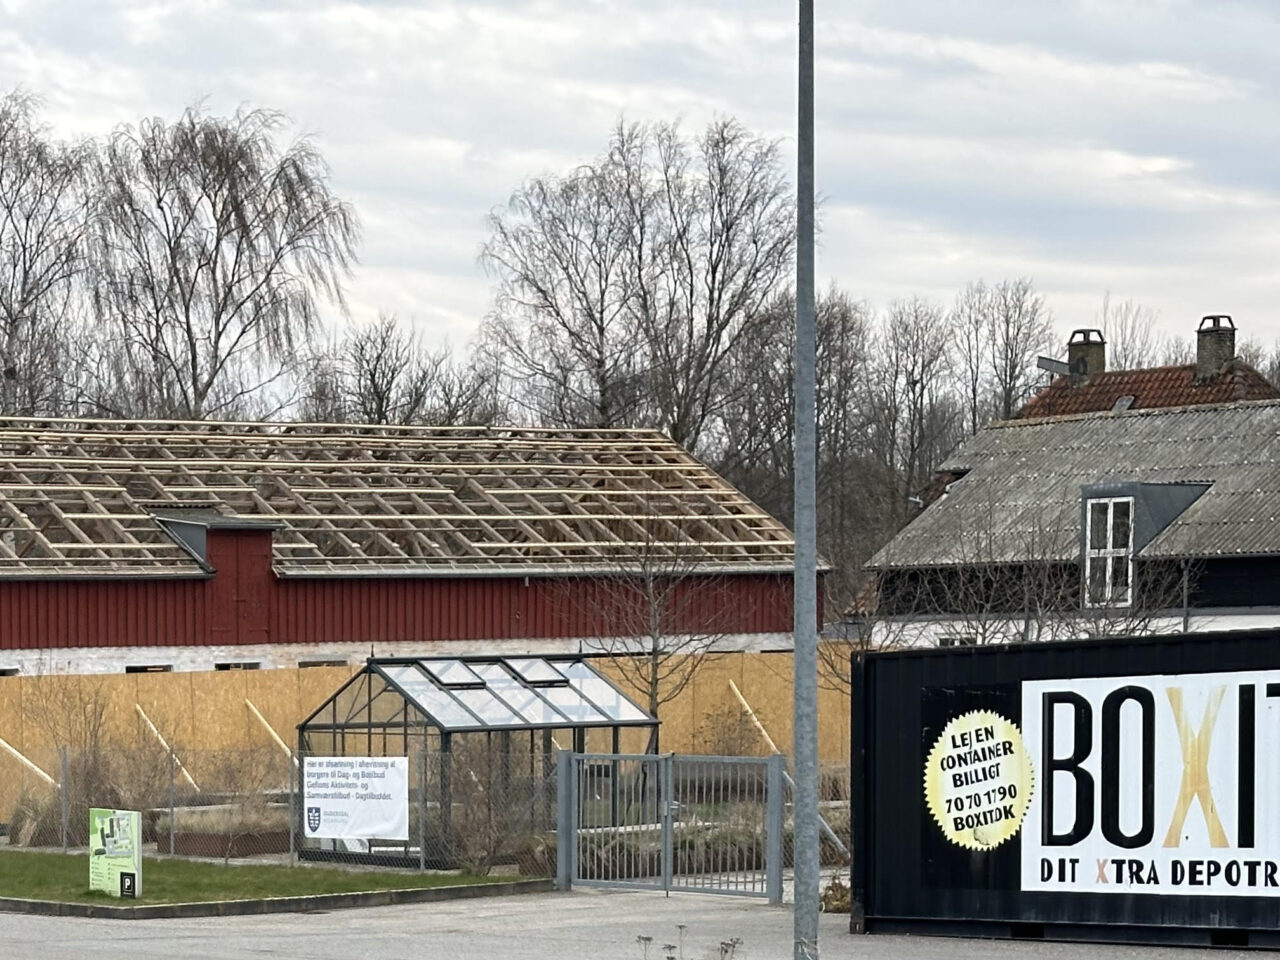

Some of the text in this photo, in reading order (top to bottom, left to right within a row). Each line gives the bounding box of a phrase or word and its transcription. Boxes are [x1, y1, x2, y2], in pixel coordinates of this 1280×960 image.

[951, 725, 995, 750] LEJ EN
[940, 740, 1014, 771] CONTAINER
[952, 763, 1000, 788] BILLIGT
[945, 797, 964, 813] 70
[966, 793, 981, 809] 70
[124, 878, 131, 889] P
[1040, 858, 1080, 883] DIT
[1096, 858, 1160, 886] XTRA
